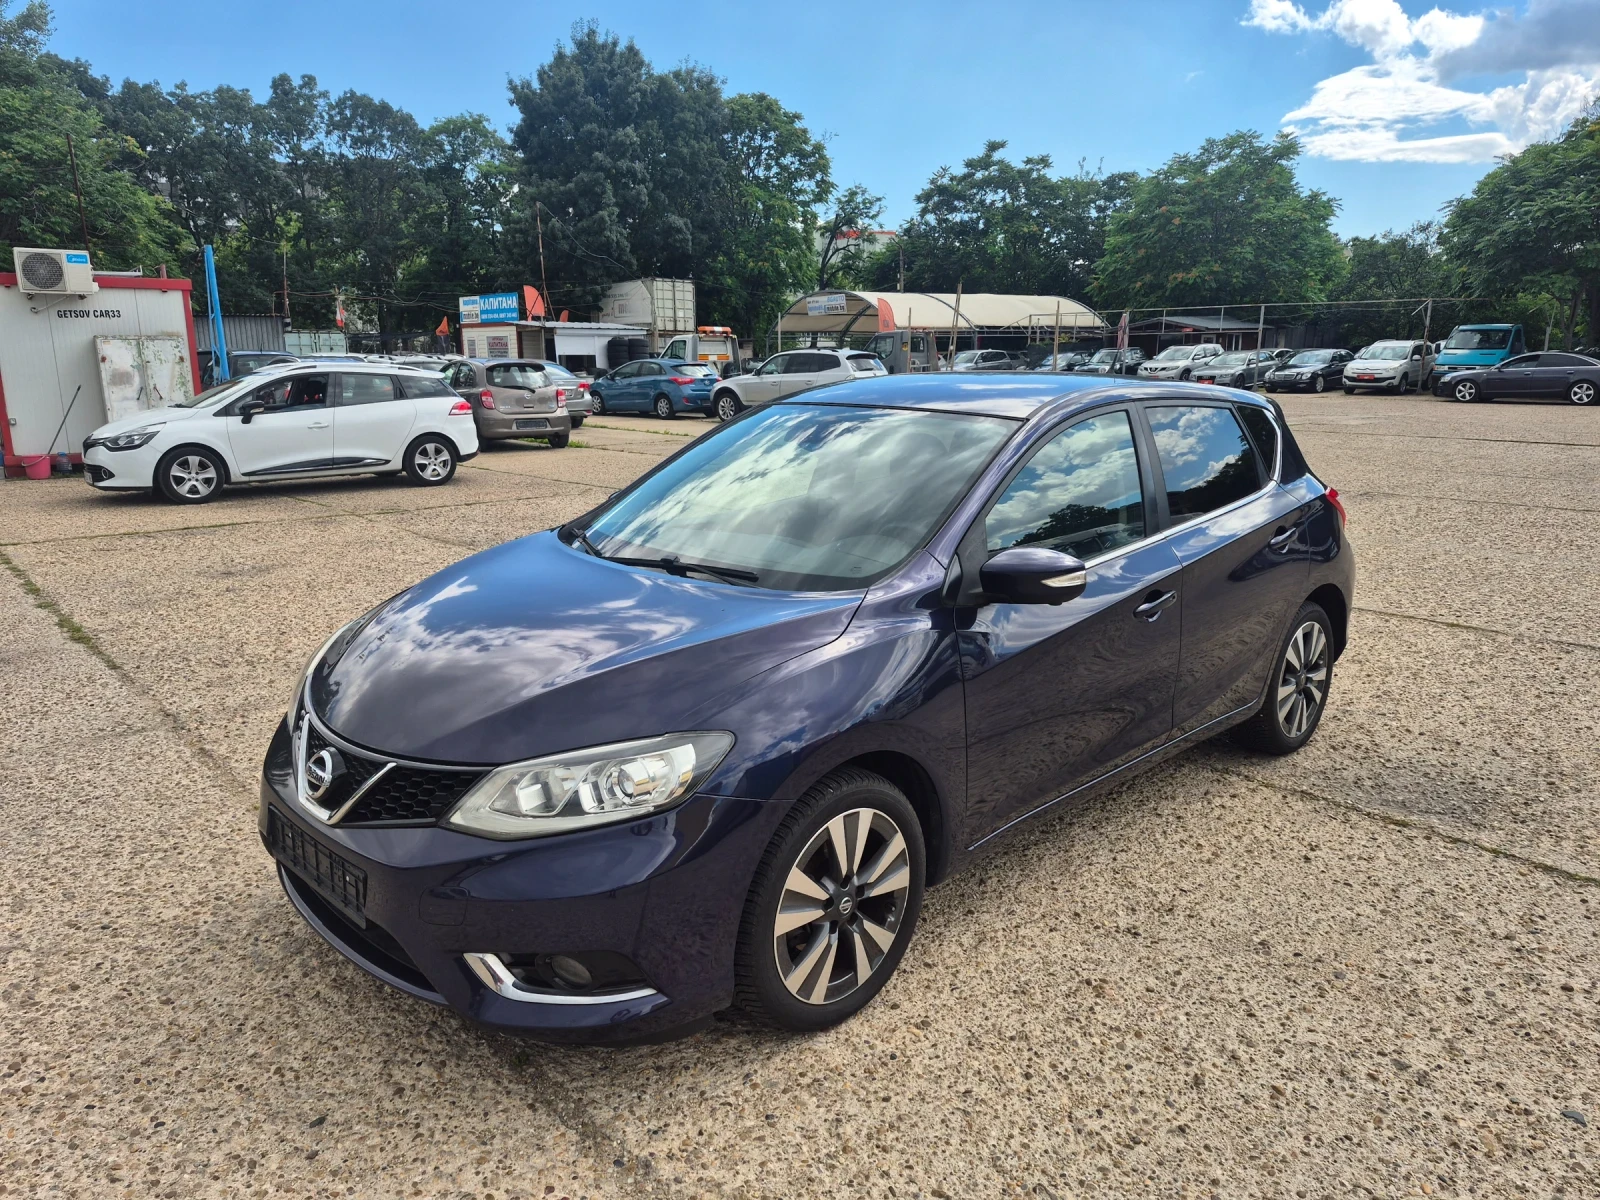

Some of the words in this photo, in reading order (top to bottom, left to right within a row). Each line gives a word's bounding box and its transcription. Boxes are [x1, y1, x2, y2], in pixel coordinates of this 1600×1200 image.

[481, 296, 517, 310] КАПИТАНА
[57, 309, 90, 319] GETSOV
[93, 310, 121, 320] CAR33
